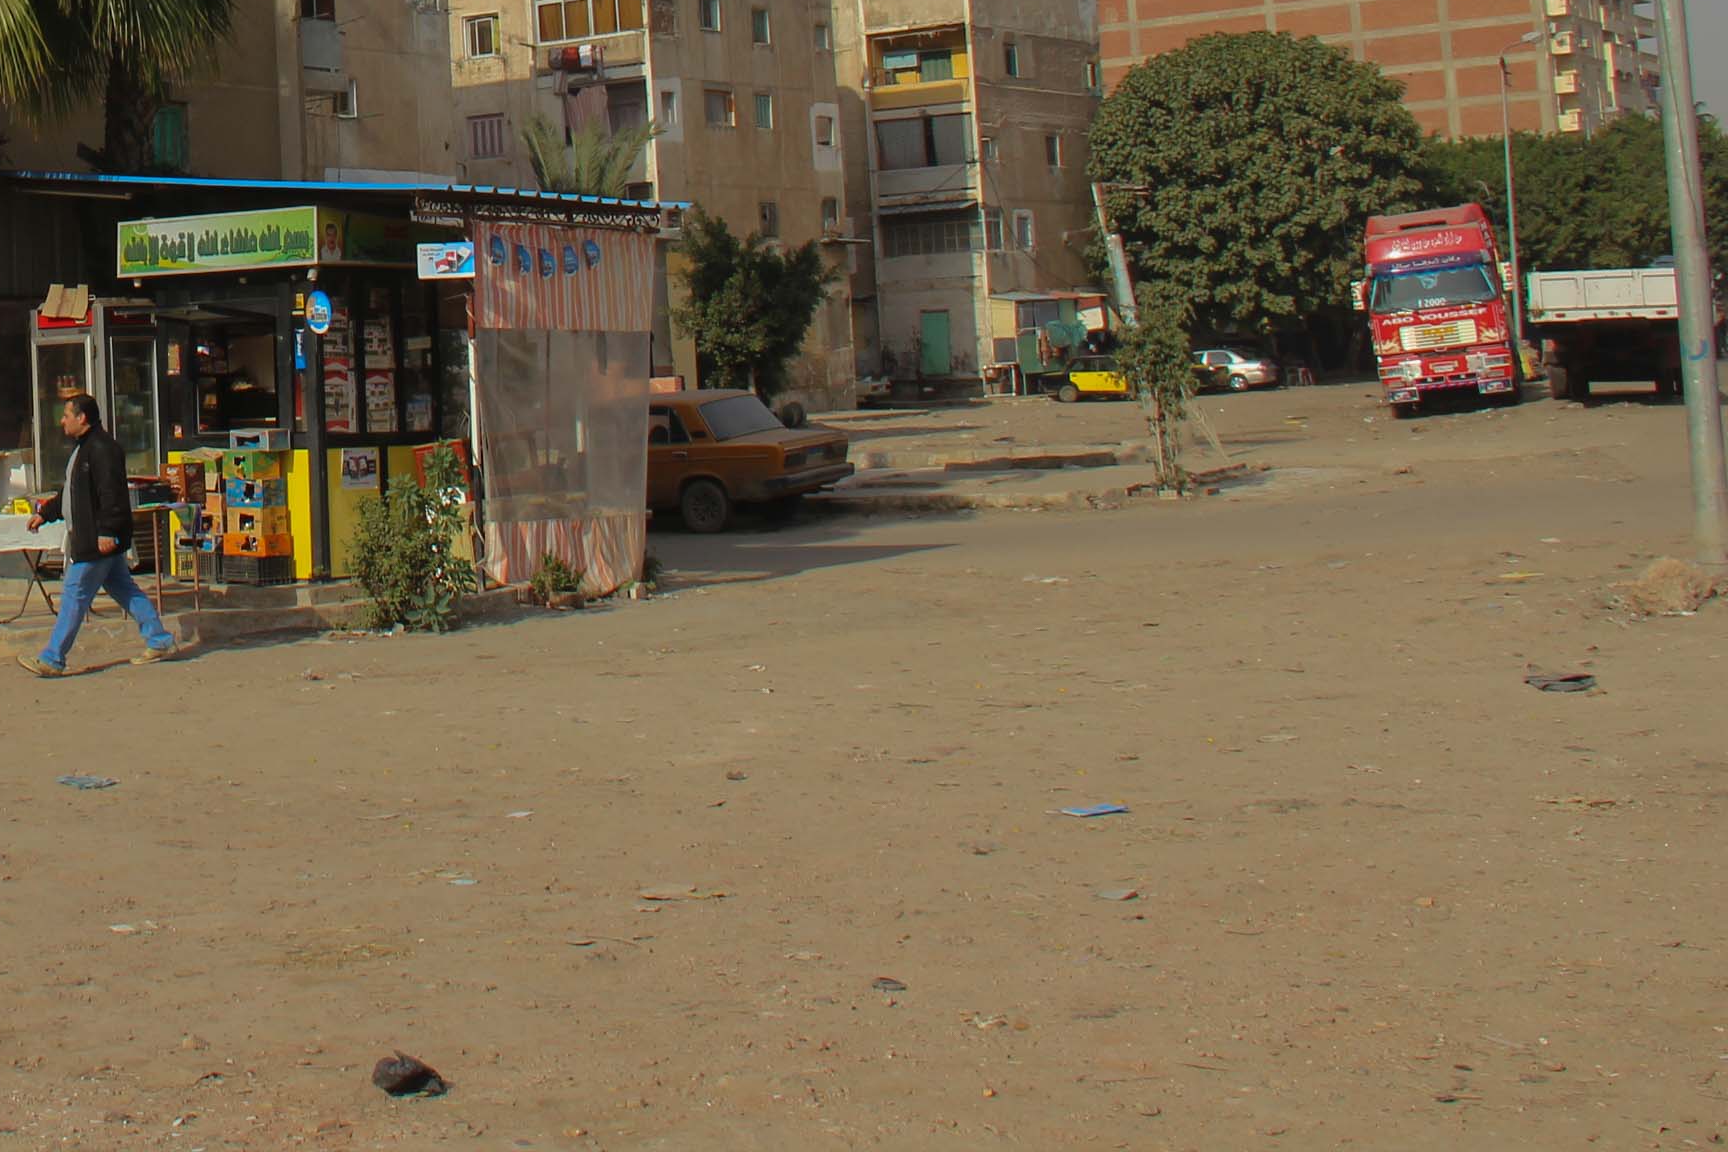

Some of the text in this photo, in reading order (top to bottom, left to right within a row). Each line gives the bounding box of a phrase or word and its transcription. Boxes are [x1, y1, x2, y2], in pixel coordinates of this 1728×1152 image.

[197, 229, 219, 257] الله
[258, 224, 282, 252] الله
[1382, 307, 1488, 326] ABO YOUSSEF
